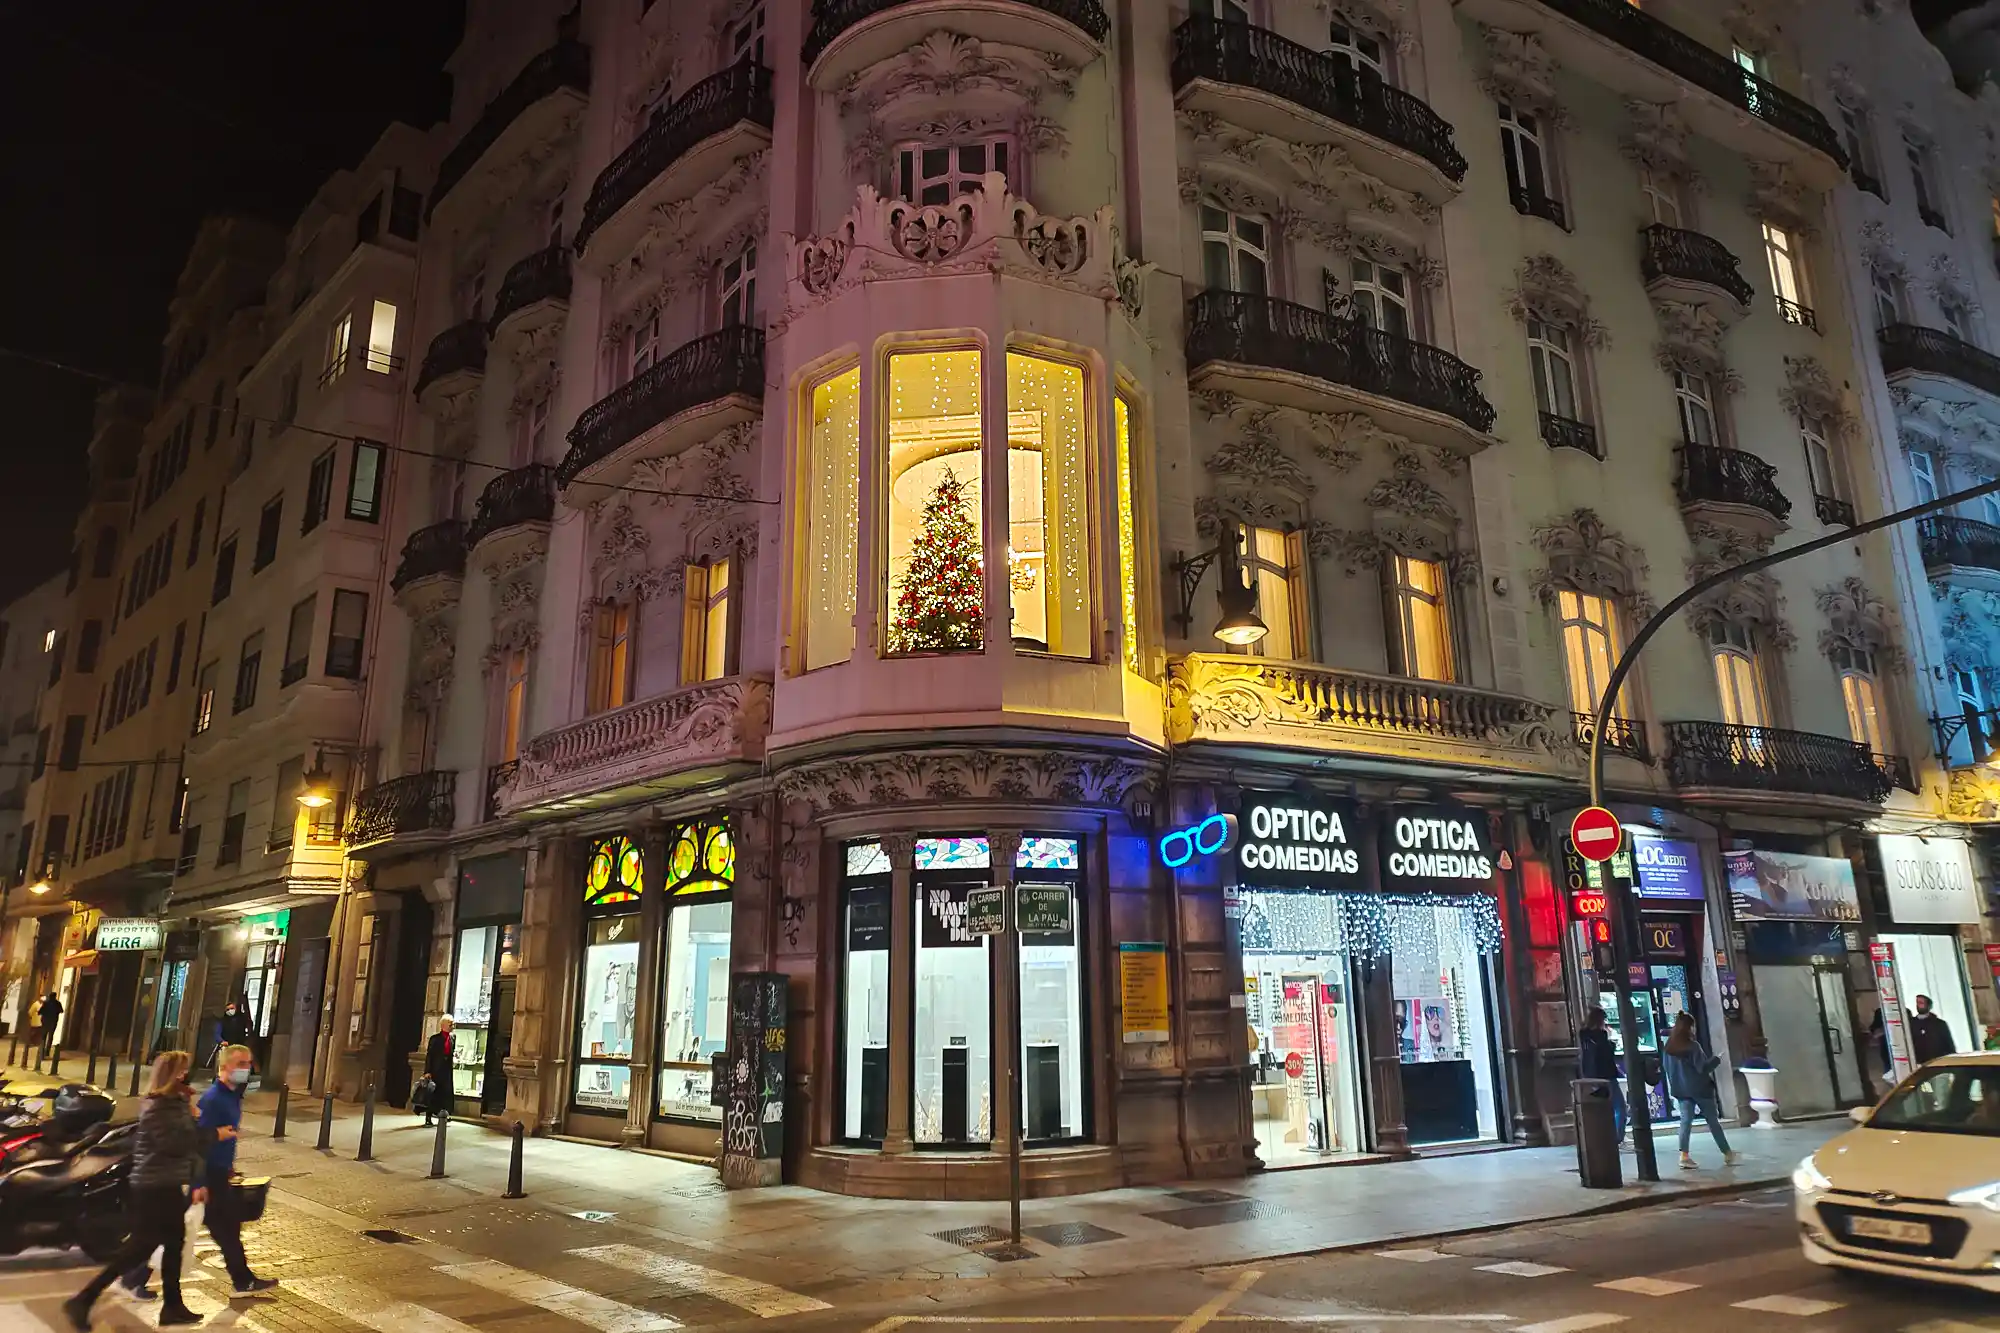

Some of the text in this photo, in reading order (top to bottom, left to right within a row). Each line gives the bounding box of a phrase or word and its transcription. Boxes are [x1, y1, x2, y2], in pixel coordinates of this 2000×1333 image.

[1251, 805, 1346, 844] OPTICA
[1396, 817, 1480, 851] OPTICA
[1241, 844, 1359, 874] COMEDIAS
[1390, 853, 1492, 880] COMEDIAS
[930, 889, 950, 908] NO
[978, 892, 1000, 904] CARRER
[1032, 892, 1064, 900] CARRER
[1028, 914, 1058, 922] LA PAU
[100, 936, 141, 949] LARA
[1654, 930, 1676, 948] OC
